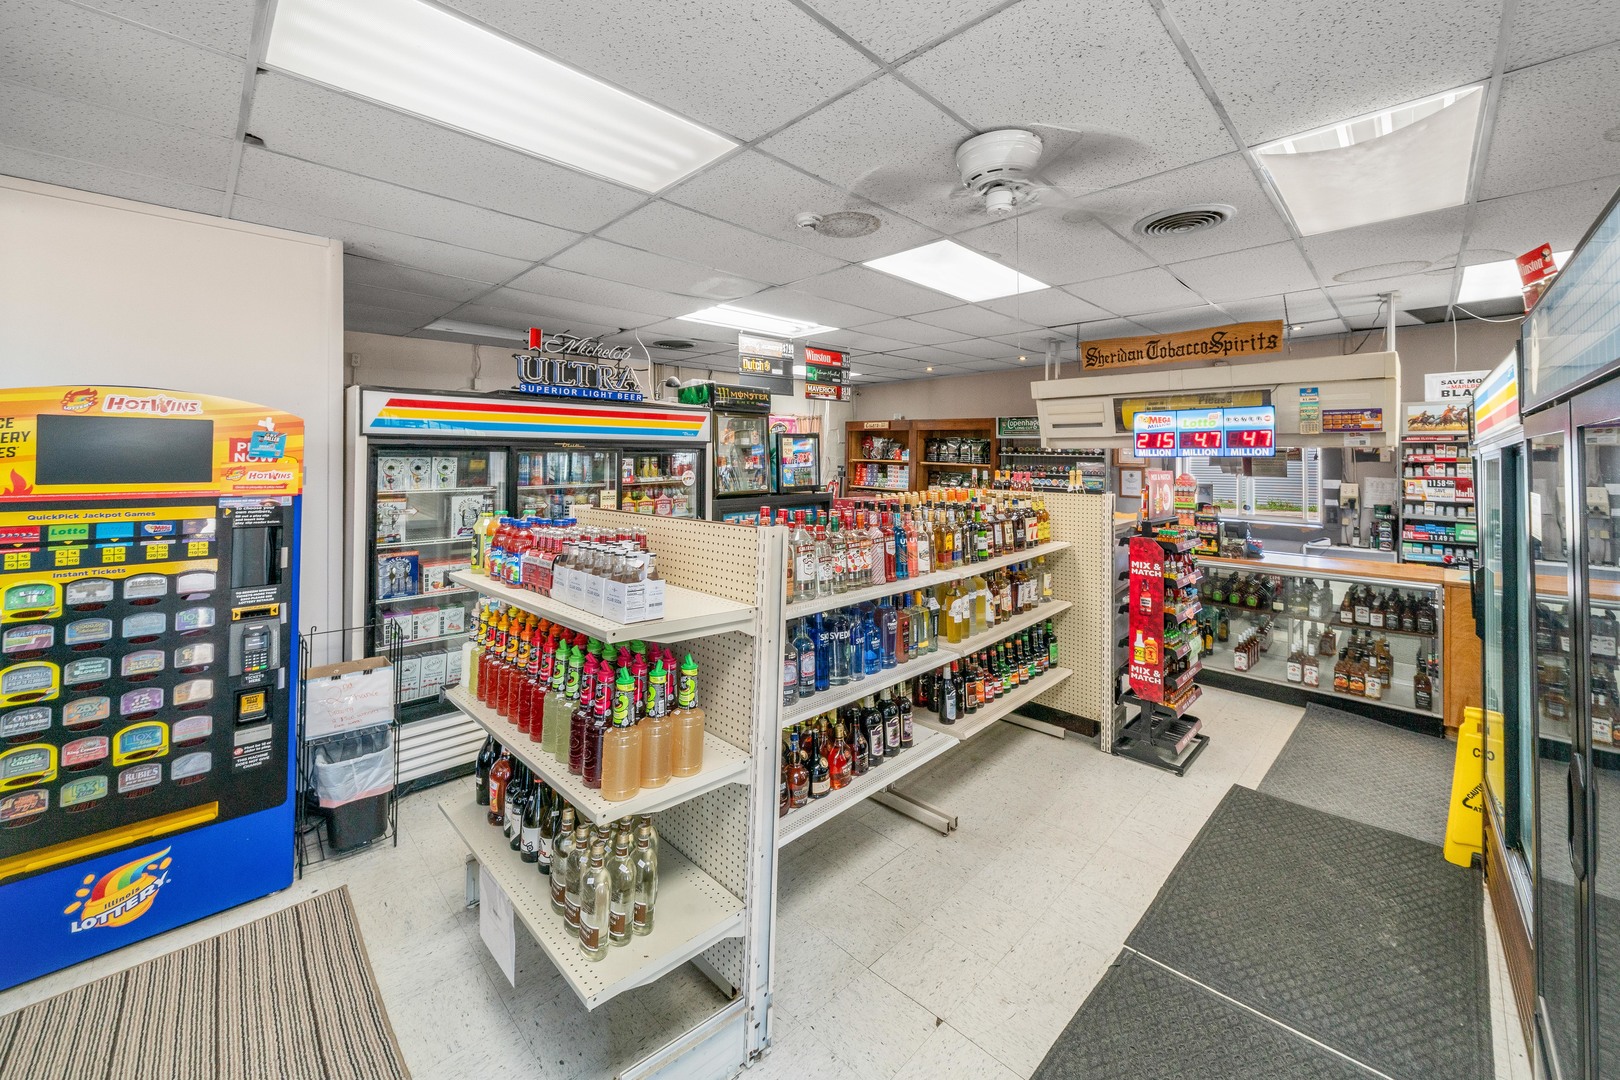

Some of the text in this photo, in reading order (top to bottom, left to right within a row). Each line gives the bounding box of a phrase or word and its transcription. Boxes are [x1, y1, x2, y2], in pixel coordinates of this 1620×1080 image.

[545, 334, 632, 360] Michelob
[1085, 332, 1279, 368] Sheridan Tobacco Spirits
[806, 350, 830, 362] Winston
[742, 358, 764, 370] Dutch
[516, 356, 642, 391] ULTRA
[520, 385, 578, 396] SUPERIOR
[582, 390, 612, 398] LIGHT
[730, 391, 768, 400] MONSTER
[0, 418, 14, 428] CE
[1150, 416, 1171, 424] MEGA
[1183, 418, 1217, 428] Lotto
[0, 431, 31, 443] ERY
[1137, 432, 1174, 448] 215
[1194, 432, 1221, 448] 4.7
[1243, 430, 1271, 446] 47
[237, 442, 251, 451] P
[1131, 561, 1150, 570] MIX
[1131, 568, 1162, 577] MATCH
[1131, 665, 1150, 676] MIX
[1131, 673, 1161, 684] MATCH
[126, 768, 158, 781] RUBIES
[71, 870, 168, 933] LOTTERY
[104, 886, 140, 909] Illinois
